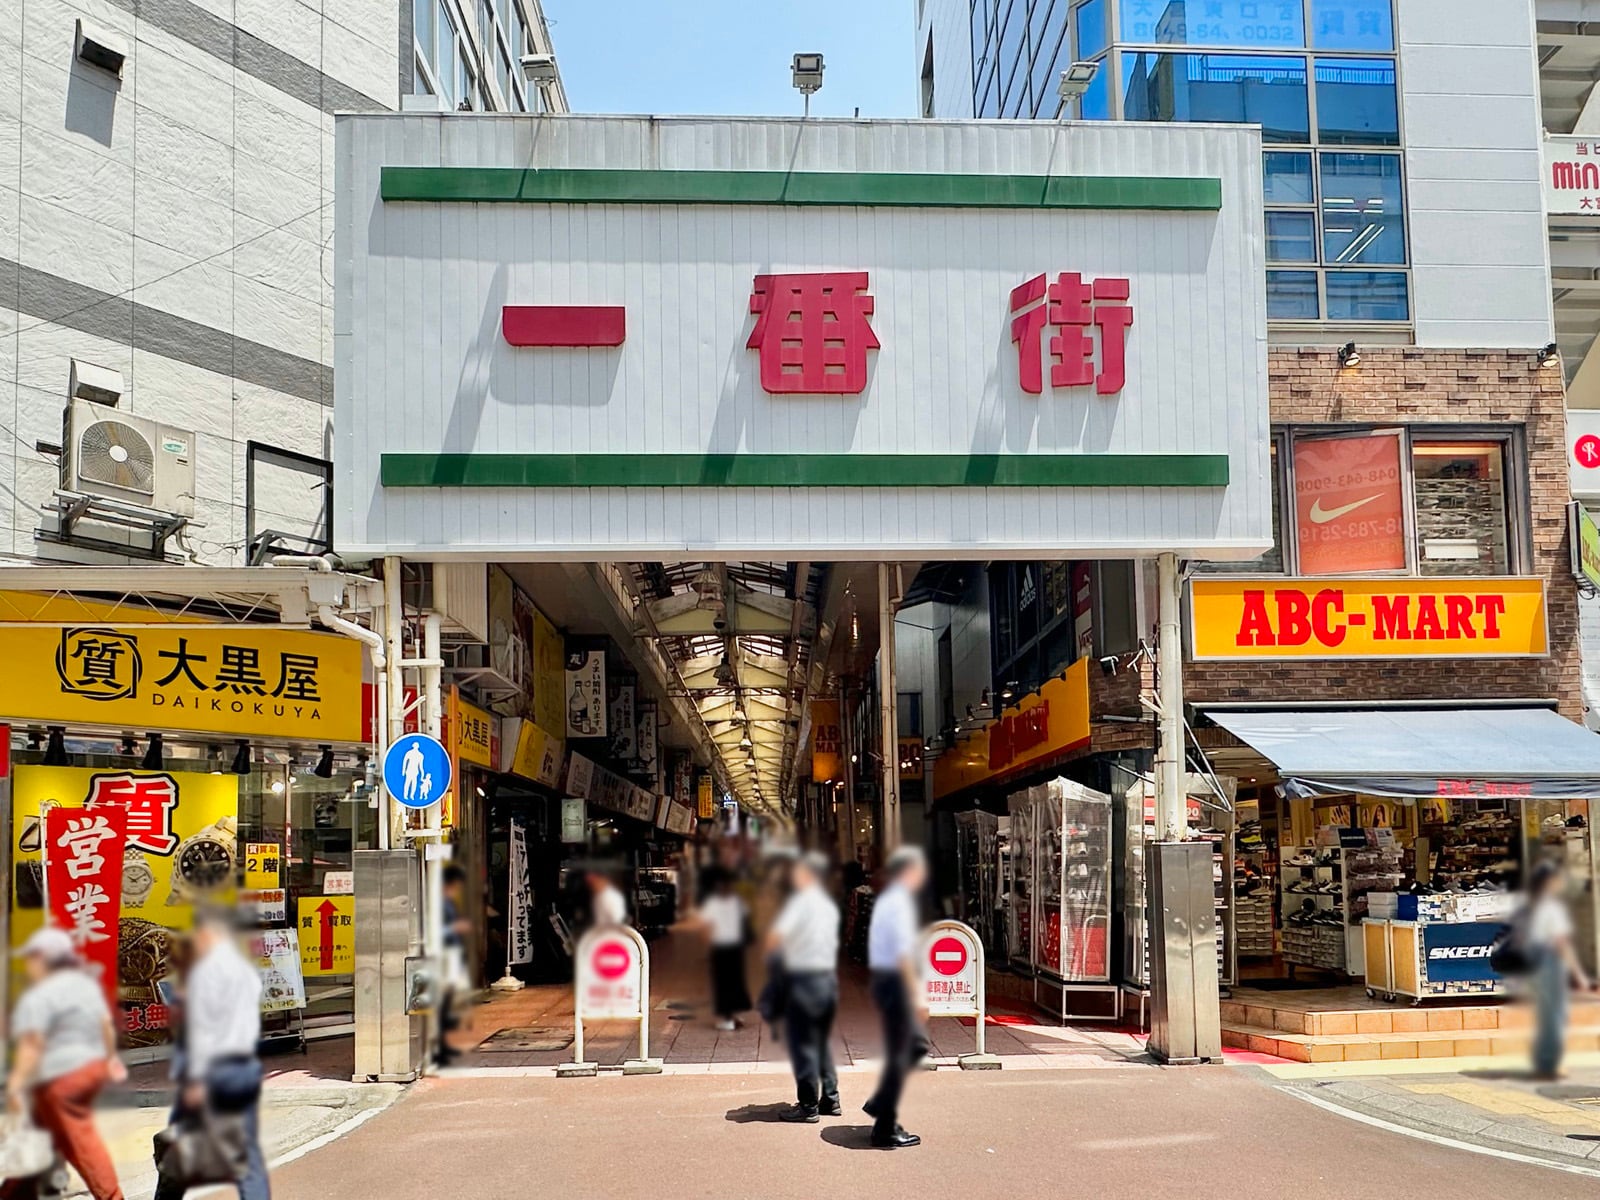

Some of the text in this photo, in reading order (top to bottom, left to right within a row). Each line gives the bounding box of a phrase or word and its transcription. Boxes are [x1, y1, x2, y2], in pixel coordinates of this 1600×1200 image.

[502, 272, 1134, 394] 一番街
[1236, 588, 1505, 647] ABC-MART
[70, 637, 322, 703] 質 大黒屋
[152, 693, 322, 721] DAIKOKUYA
[57, 816, 118, 945] 営業
[247, 857, 278, 873] 2階
